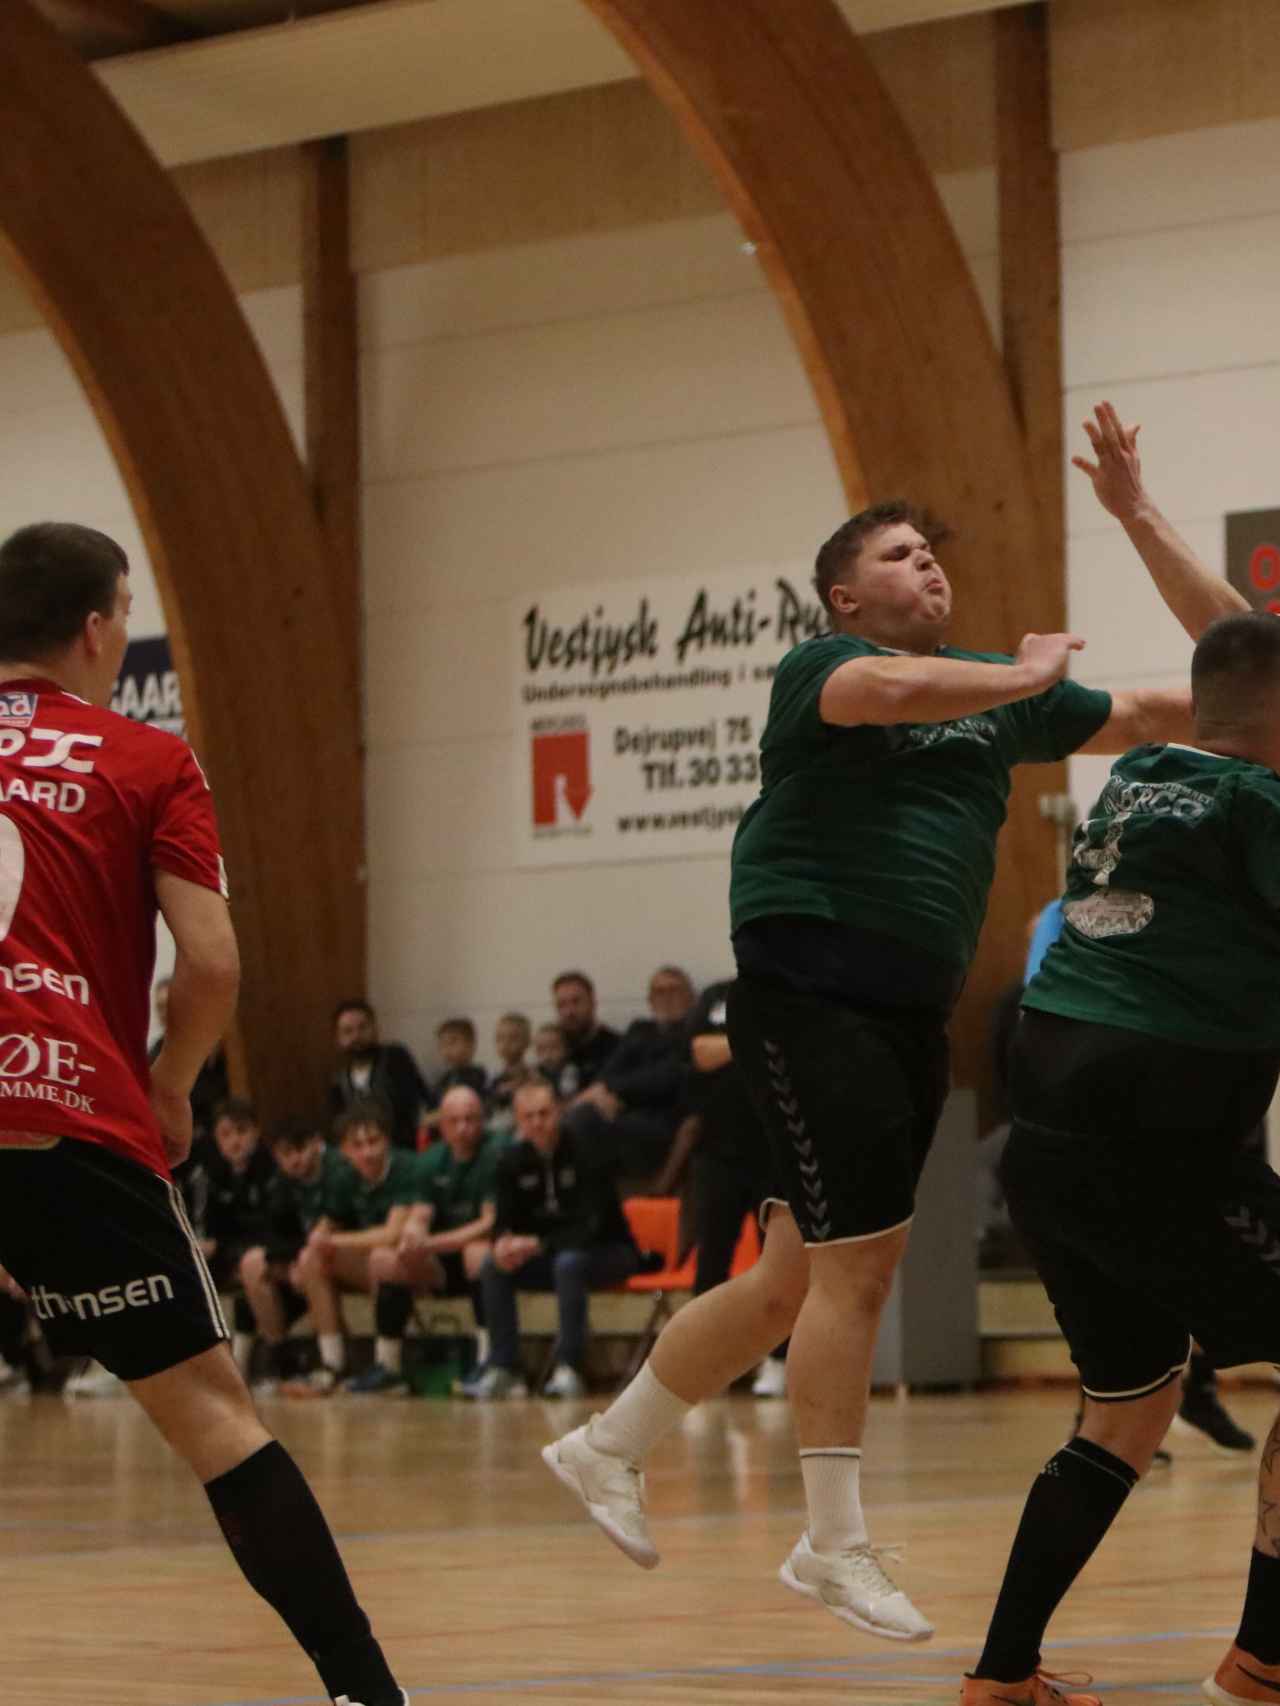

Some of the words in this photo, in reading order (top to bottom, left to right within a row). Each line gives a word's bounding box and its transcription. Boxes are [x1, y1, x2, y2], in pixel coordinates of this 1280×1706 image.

[523, 597, 659, 677] Vestjysk
[676, 577, 828, 664] Anti-Ru
[111, 671, 183, 722] AAR
[614, 722, 717, 756] Dejrupvej
[689, 756, 721, 788] 30
[31, 1273, 175, 1321] thnsen
